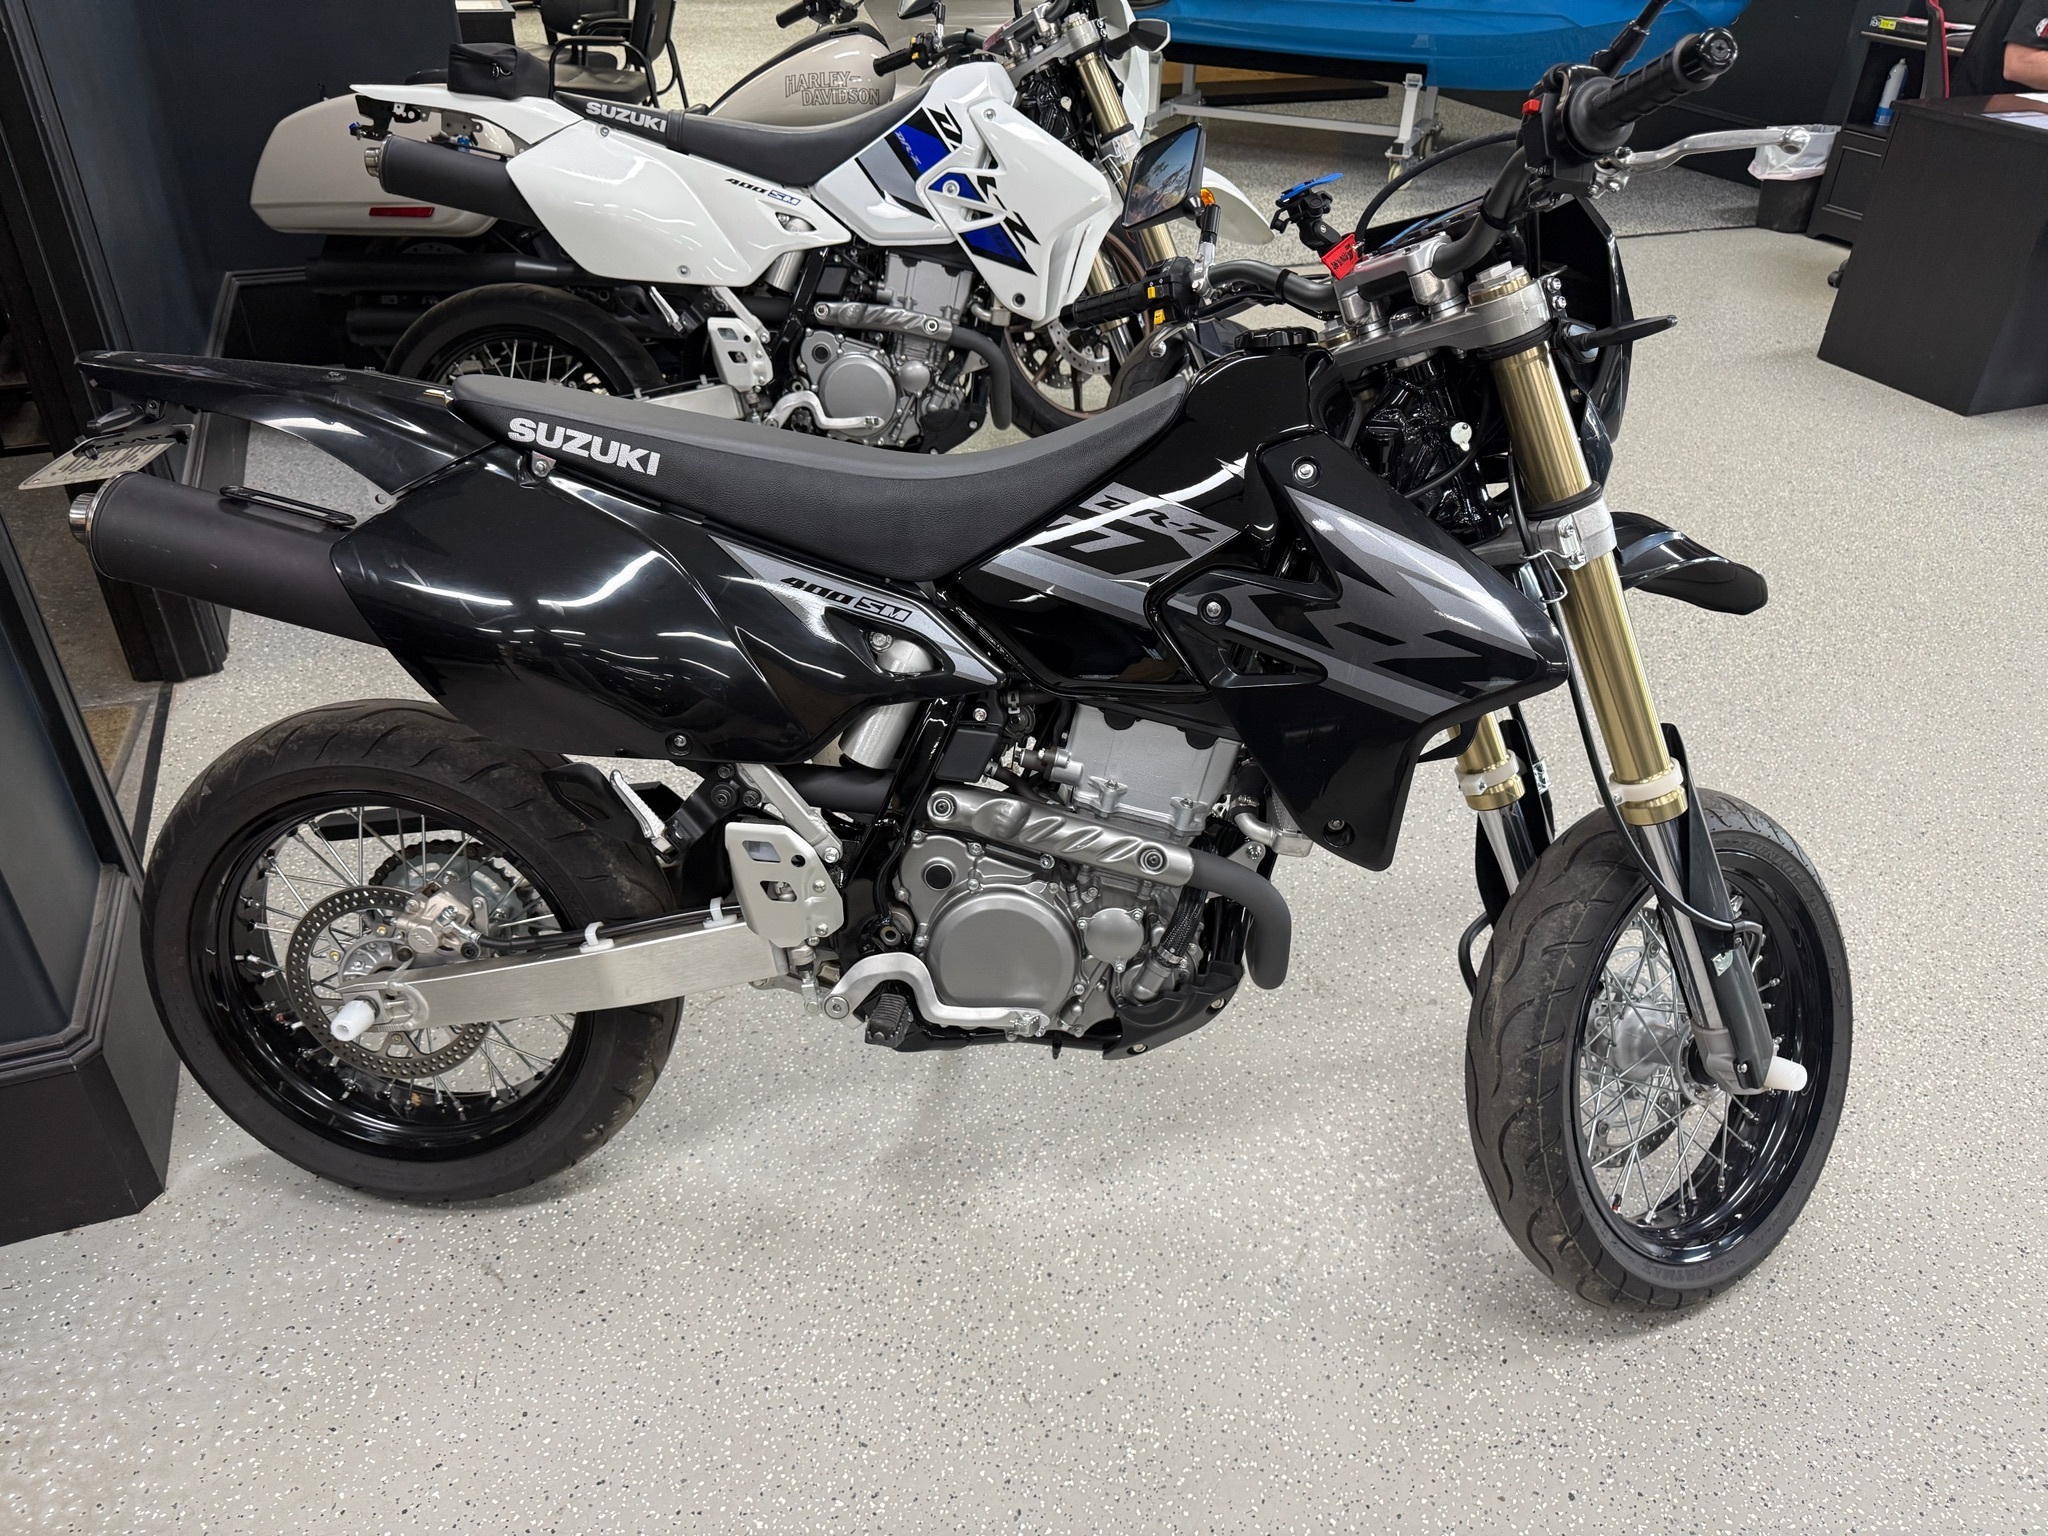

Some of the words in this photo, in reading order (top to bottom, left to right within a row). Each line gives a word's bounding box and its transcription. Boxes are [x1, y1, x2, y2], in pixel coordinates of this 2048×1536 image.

[784, 71, 861, 98] HARLEY-
[801, 87, 880, 106] DAVIDSON
[585, 101, 667, 133] SUZUKI
[895, 131, 922, 166] DR-Z
[725, 178, 768, 194] 400
[768, 189, 801, 206] SM
[508, 417, 661, 476] SUZUKI
[780, 577, 856, 605] 400
[853, 596, 912, 622] SM
